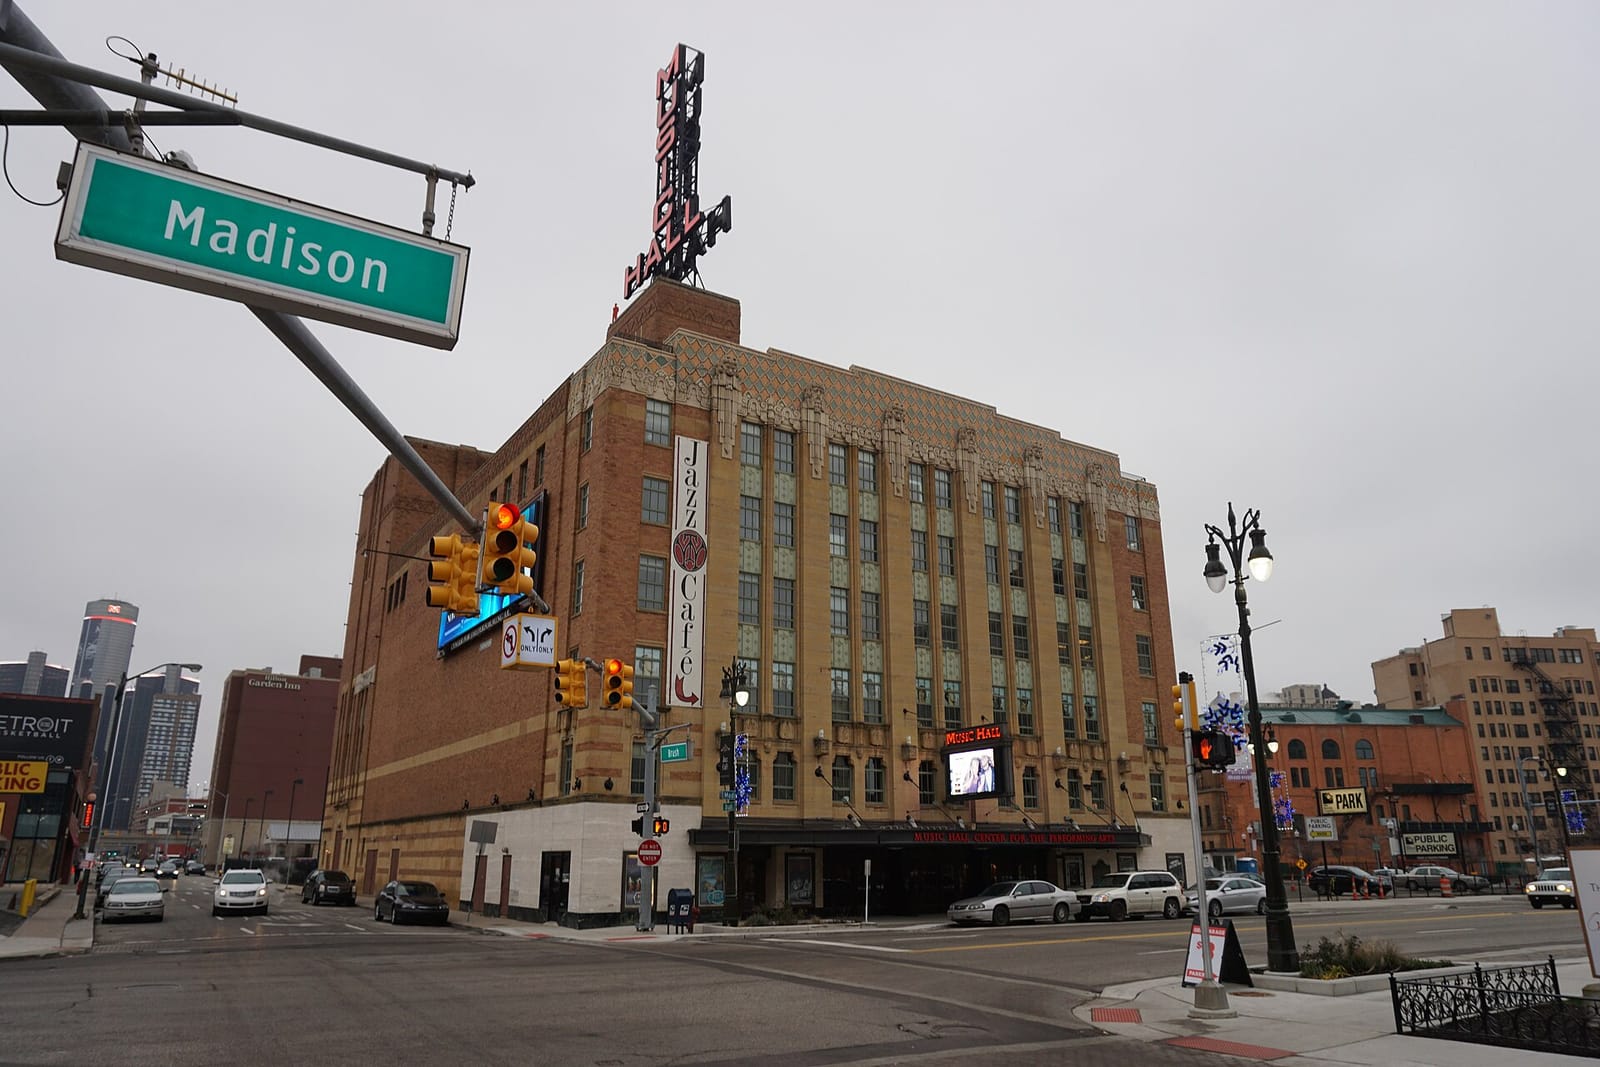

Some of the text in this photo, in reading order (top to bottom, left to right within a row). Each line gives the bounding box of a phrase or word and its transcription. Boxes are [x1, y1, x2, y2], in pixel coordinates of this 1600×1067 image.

[653, 42, 681, 234] MUSIC
[164, 199, 388, 293] Madison
[624, 199, 701, 300] HALL
[683, 441, 699, 529] Jazz
[680, 574, 697, 676] Café
[520, 643, 554, 654] ONLY ONLY
[248, 678, 301, 691] Garden Inn
[667, 747, 680, 758] Brush
[0, 762, 31, 776] LIC
[0, 777, 41, 791] ING
[1335, 792, 1364, 810] PARK
[914, 832, 944, 842] MUSIC
[949, 832, 969, 842] HALL
[1414, 835, 1448, 843] PUBLIC
[1415, 844, 1455, 852] PARKING
